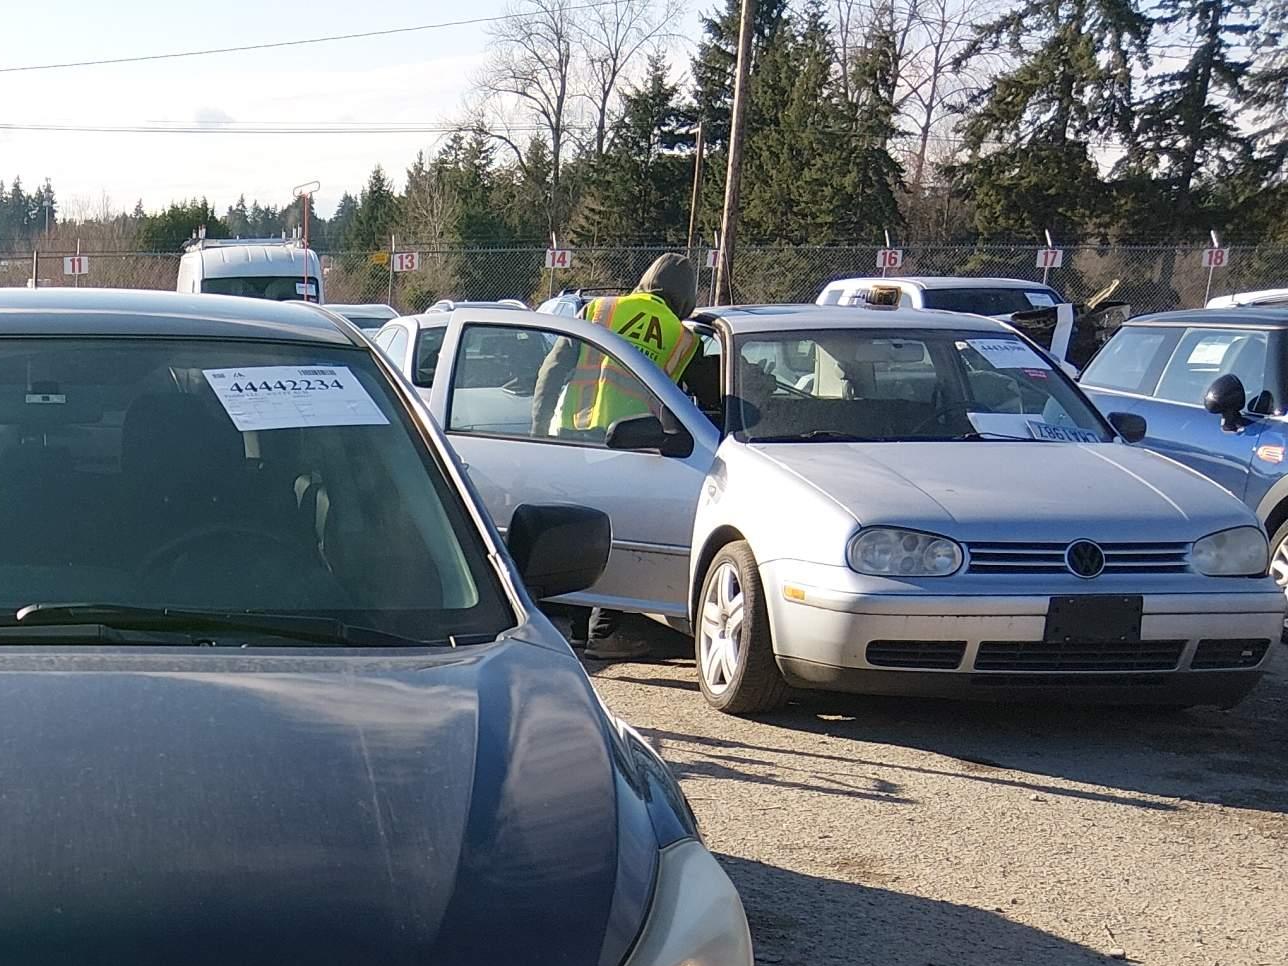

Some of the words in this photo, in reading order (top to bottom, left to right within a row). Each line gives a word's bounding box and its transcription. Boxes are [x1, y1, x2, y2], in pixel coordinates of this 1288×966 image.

[69, 257, 82, 274] 11
[397, 254, 415, 270] 13
[550, 251, 568, 267] 14
[881, 250, 899, 267] 16
[1042, 251, 1058, 267] 17
[1207, 250, 1225, 266] 18
[229, 379, 345, 394] 44442234
